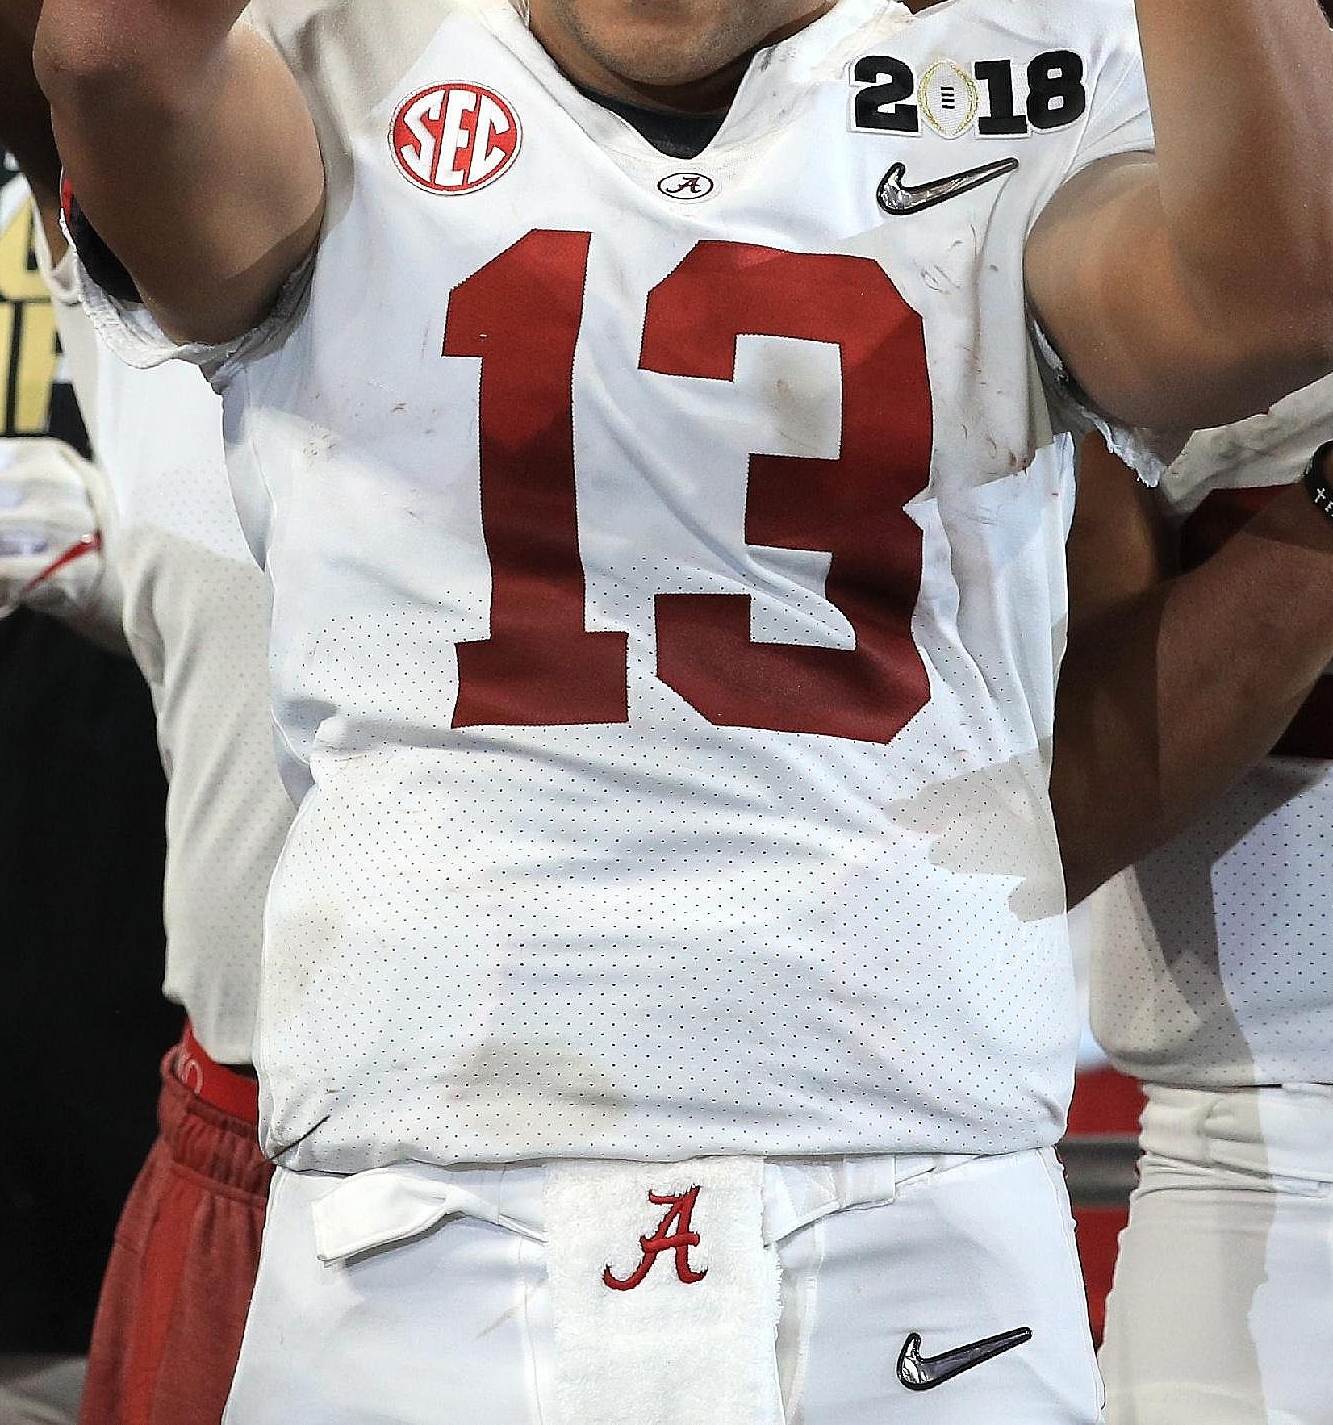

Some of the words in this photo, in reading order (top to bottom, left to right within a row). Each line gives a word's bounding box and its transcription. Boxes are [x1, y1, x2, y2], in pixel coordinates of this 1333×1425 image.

[395, 85, 516, 190] SEC
[442, 229, 933, 744] 13
[603, 1183, 709, 1291] A
